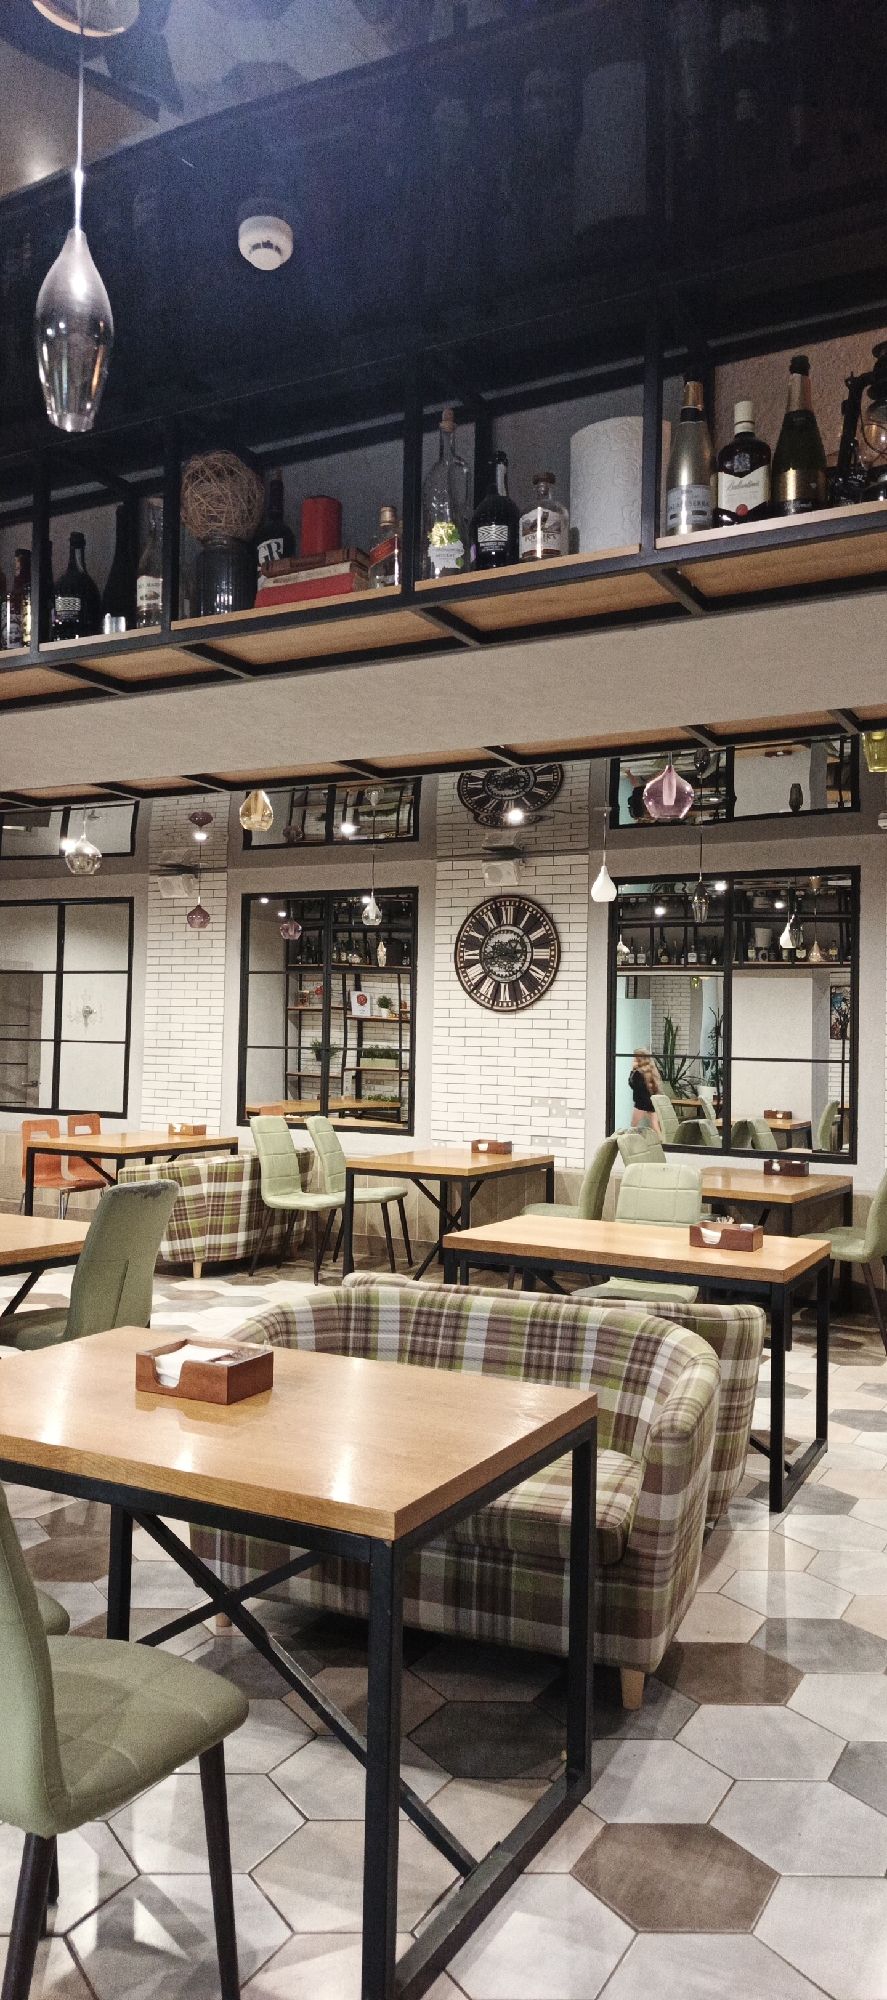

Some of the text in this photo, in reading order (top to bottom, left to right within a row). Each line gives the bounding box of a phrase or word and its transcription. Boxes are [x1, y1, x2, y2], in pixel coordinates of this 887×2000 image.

[482, 910, 497, 930] XI
[500, 905, 515, 925] XII
[519, 910, 531, 928] I
[529, 926, 546, 941] II
[532, 948, 551, 960] III
